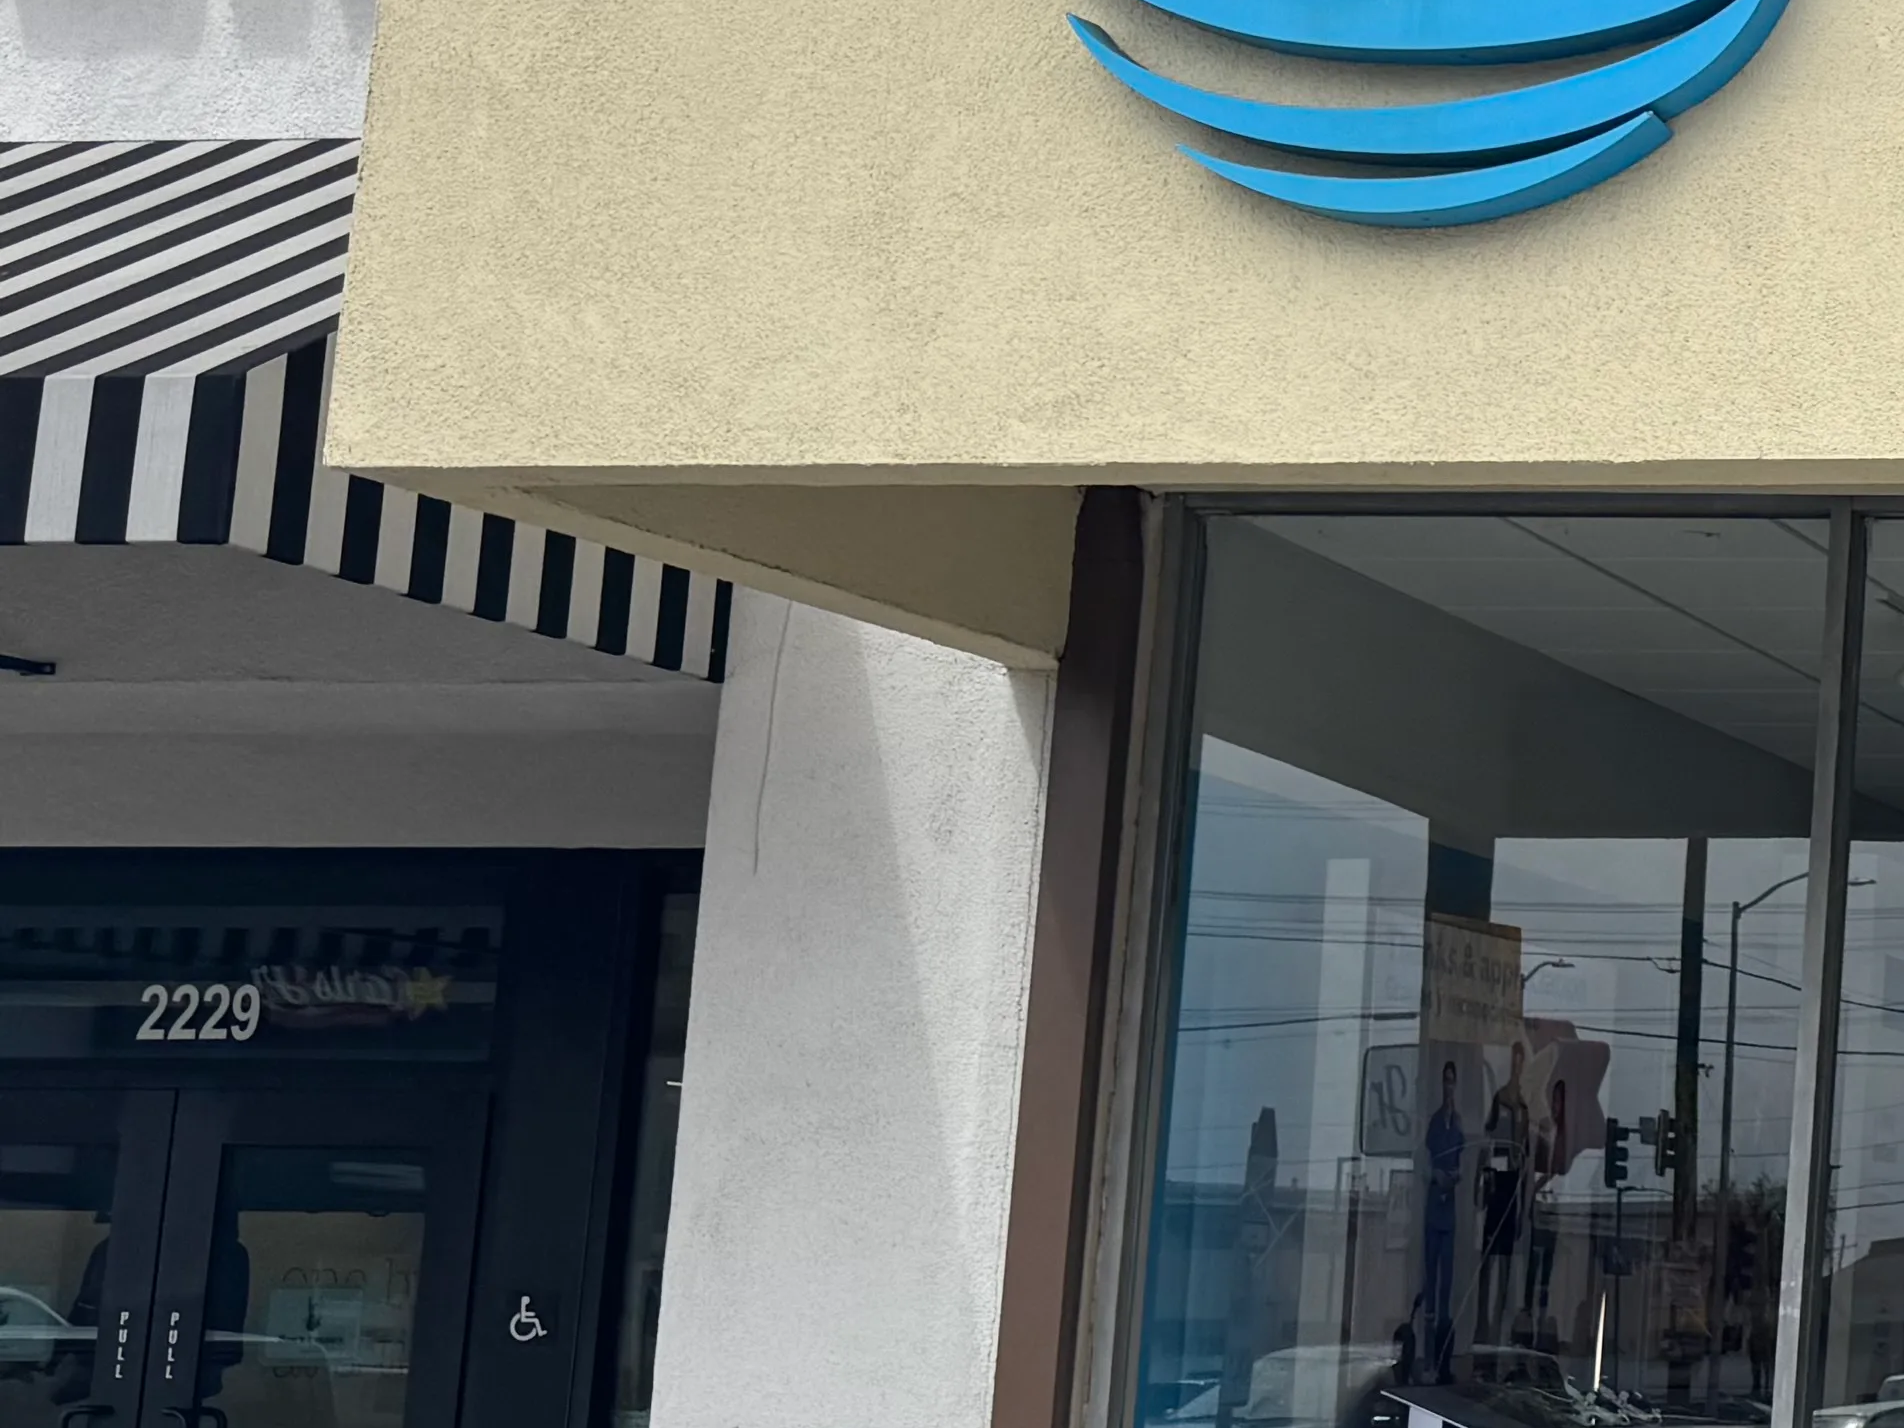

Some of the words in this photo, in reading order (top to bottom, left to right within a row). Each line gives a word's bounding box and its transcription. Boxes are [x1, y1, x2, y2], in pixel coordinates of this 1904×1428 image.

[135, 983, 261, 1042] 2229
[115, 1311, 130, 1379] PULL
[165, 1312, 180, 1379] PULL
